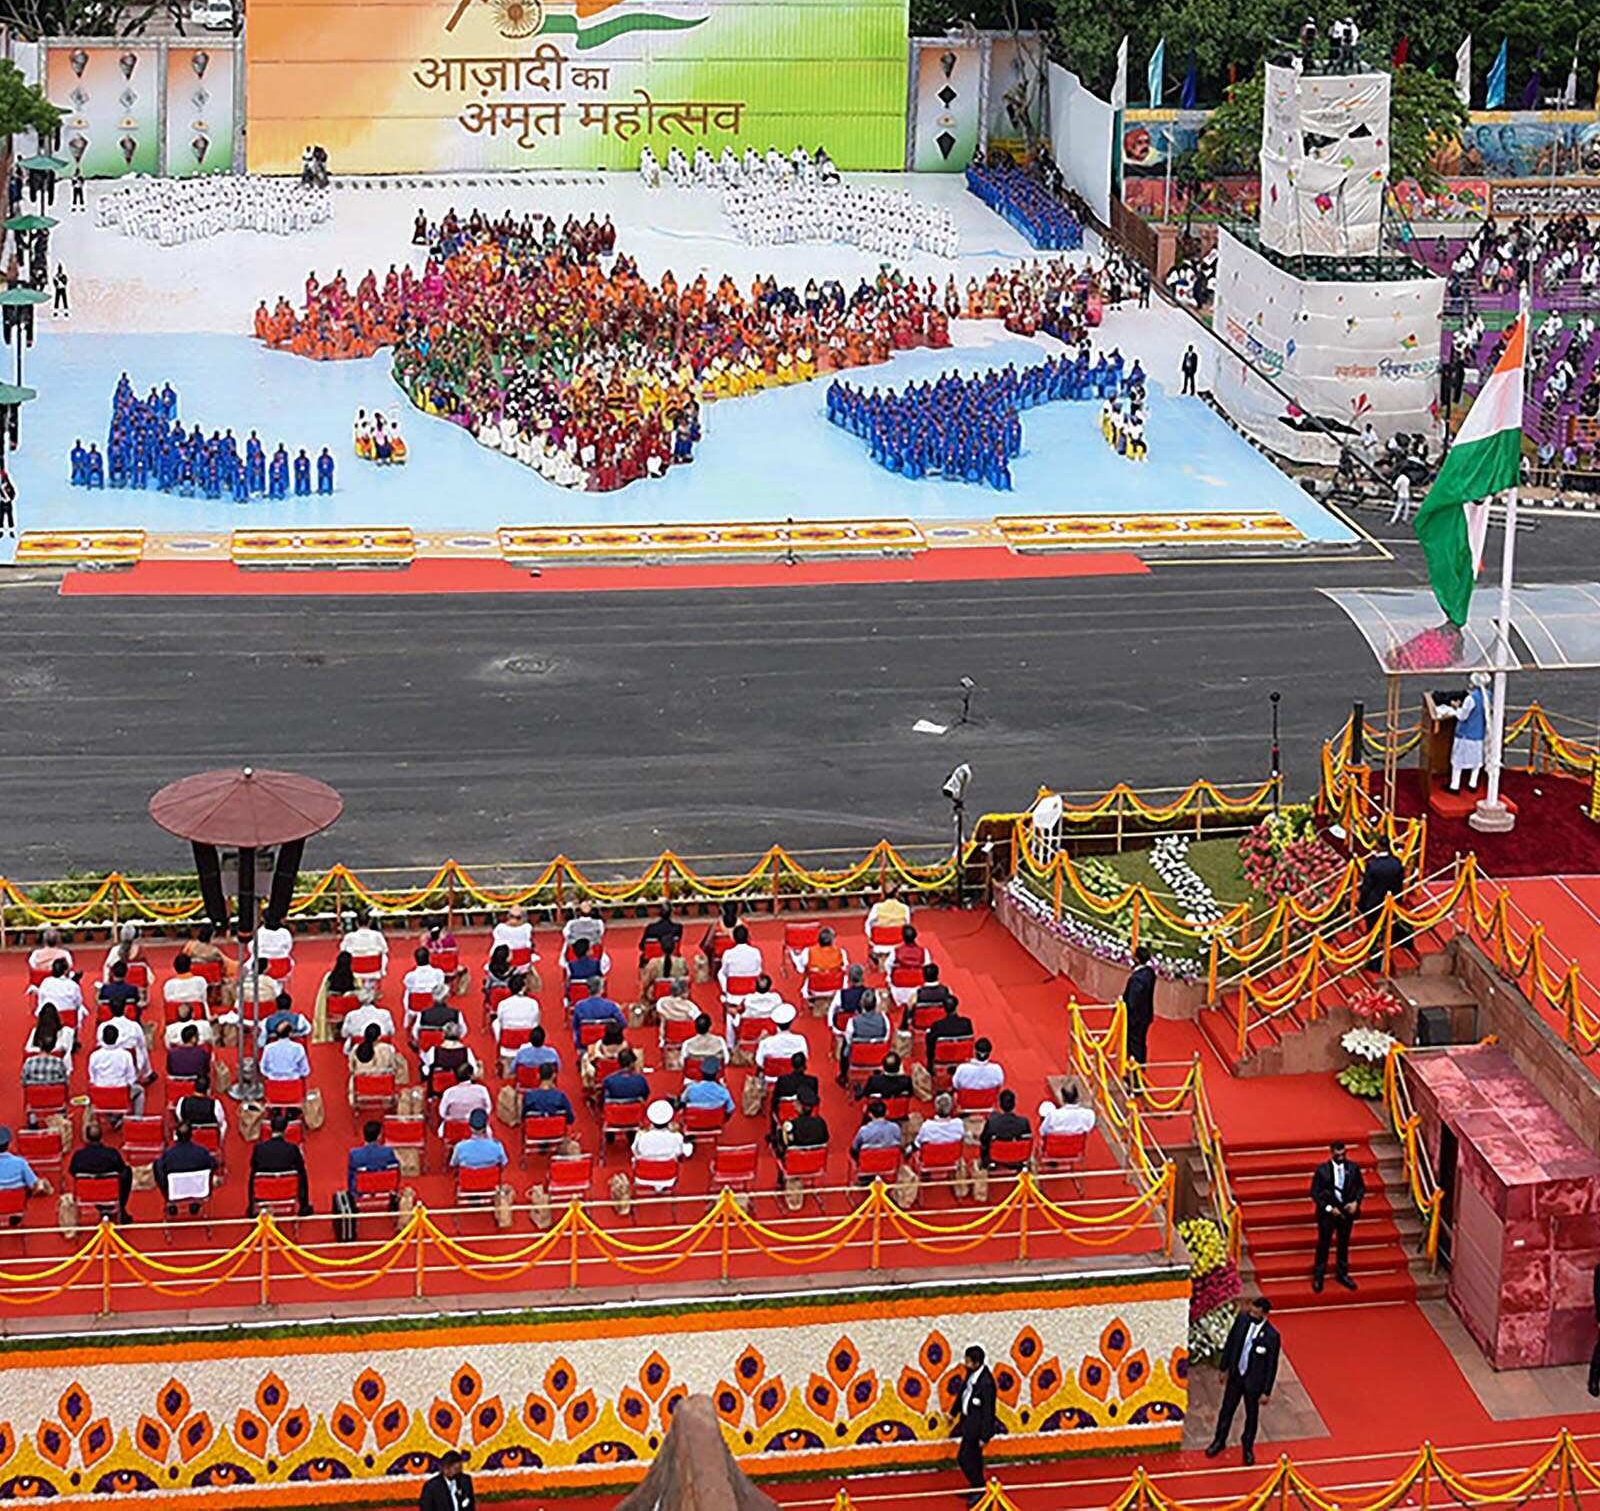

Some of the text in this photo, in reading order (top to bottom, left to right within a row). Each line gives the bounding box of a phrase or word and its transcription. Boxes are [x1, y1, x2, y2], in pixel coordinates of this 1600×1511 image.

[413, 44, 610, 97] आज़ादी का
[459, 89, 746, 149] अमृत महोत्सव
